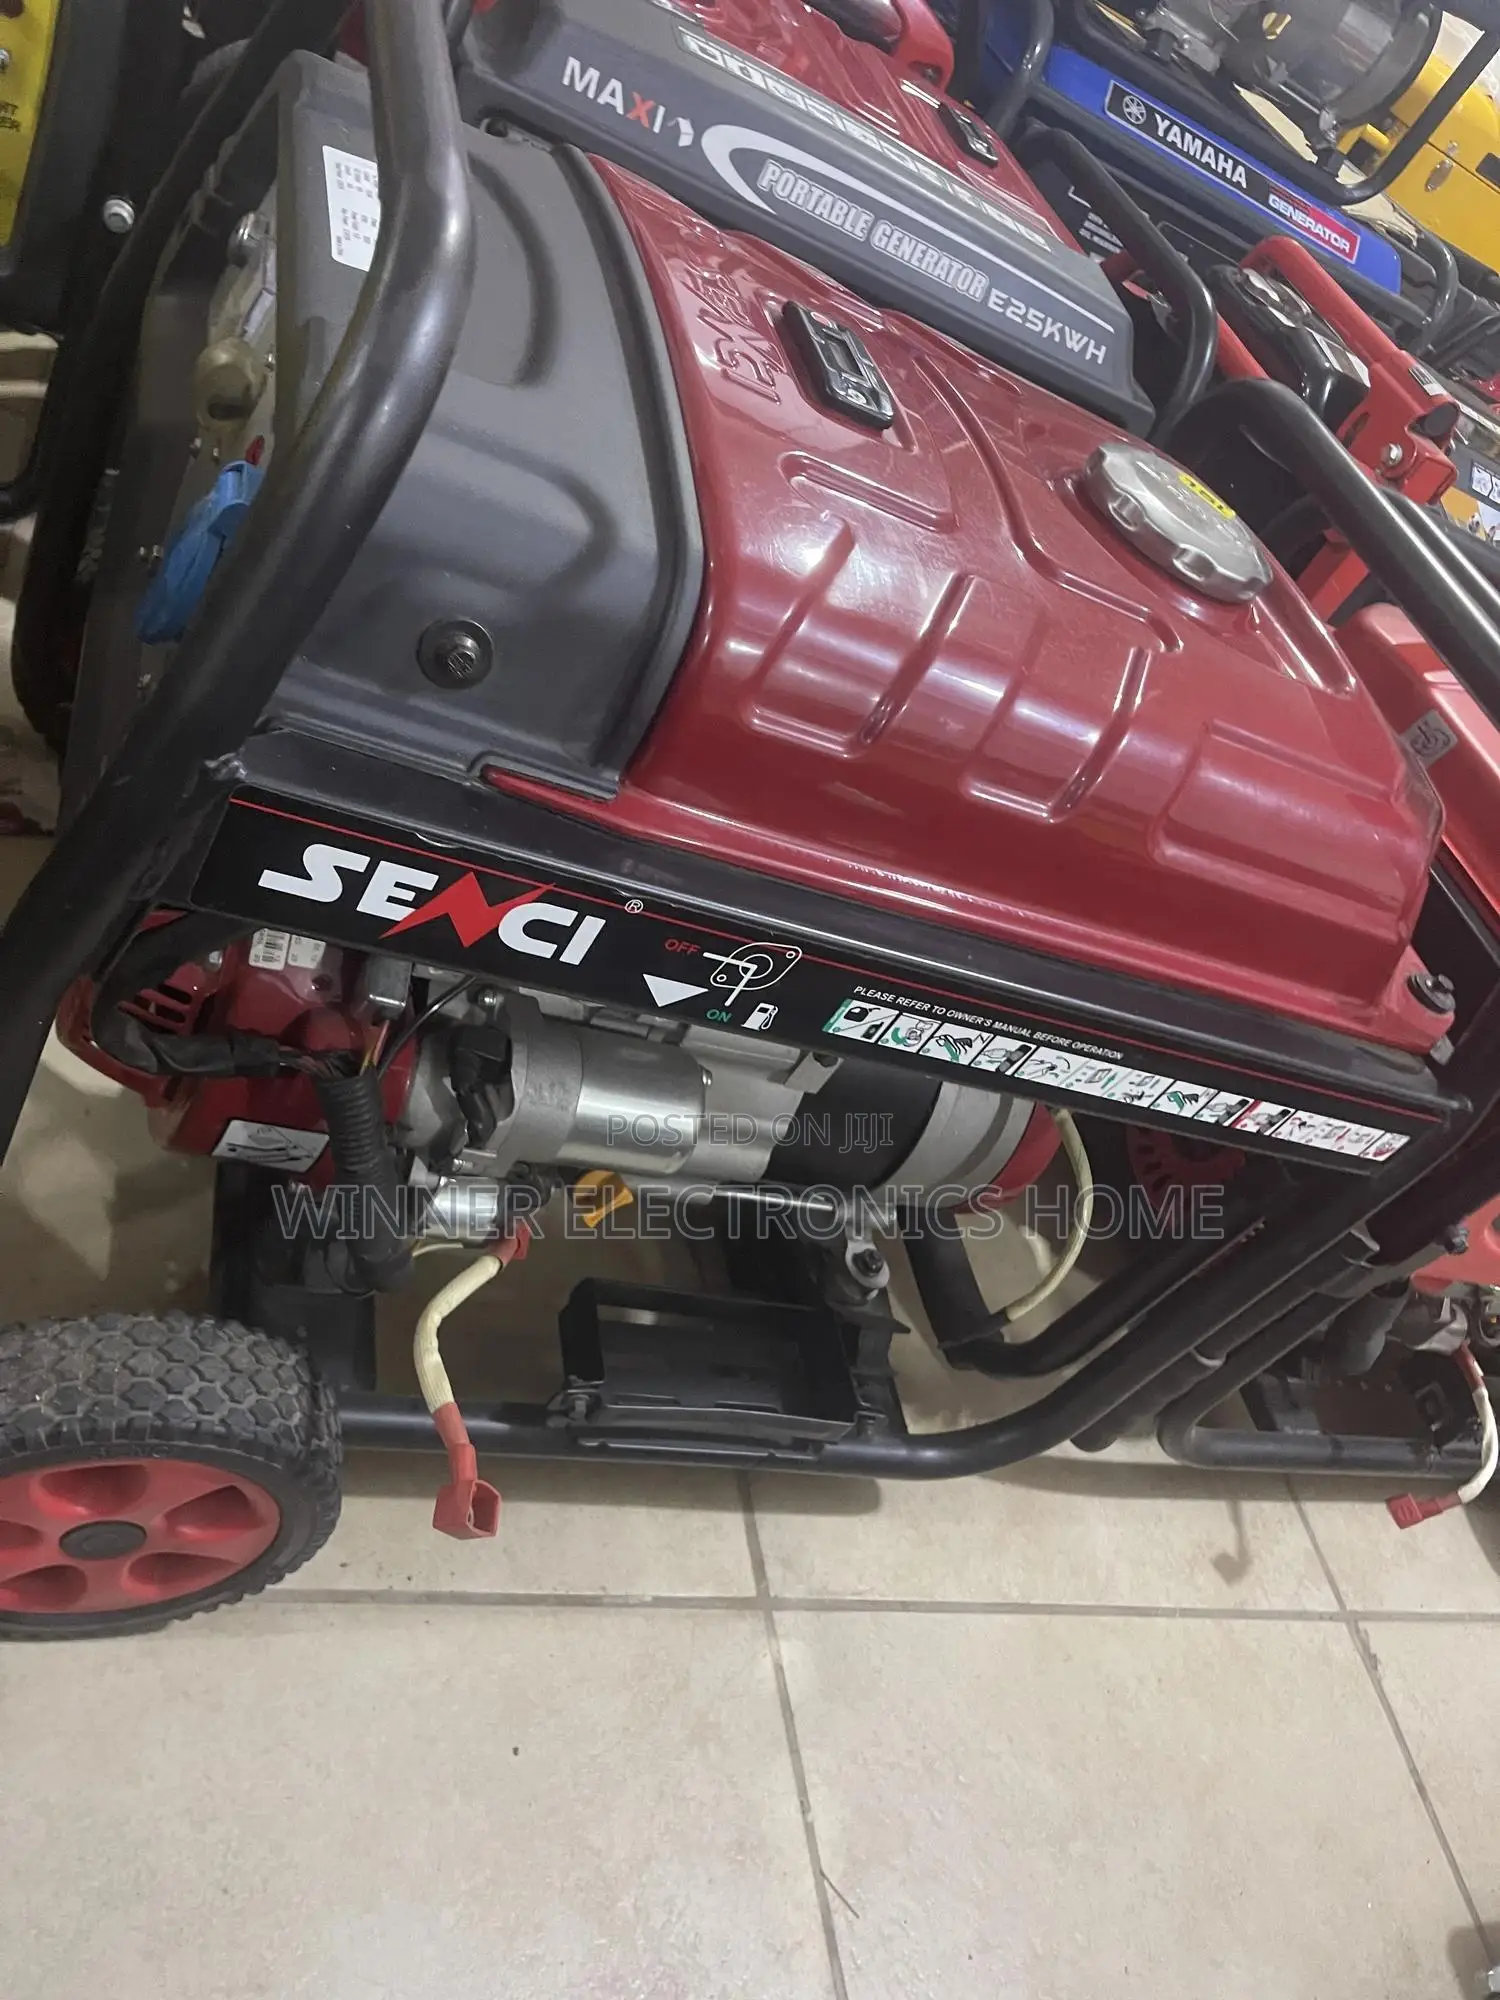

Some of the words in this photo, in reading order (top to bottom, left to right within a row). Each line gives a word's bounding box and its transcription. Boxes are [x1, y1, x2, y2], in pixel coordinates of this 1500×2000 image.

[562, 56, 666, 134] MAXI
[1154, 113, 1248, 189] YAMAHA
[1268, 192, 1350, 254] GENERATOR
[757, 159, 875, 242] PORTABLE
[869, 218, 990, 303] GENERATOR
[987, 287, 1107, 365] E25KWH
[257, 843, 606, 966] SENCI
[664, 938, 701, 955] OFF
[706, 1008, 732, 1023] ON
[854, 985, 895, 1003] PLEASE
[896, 996, 931, 1012] REFER
[931, 1004, 946, 1016] TO
[946, 1008, 993, 1027] OWNER'S
[992, 1020, 1033, 1039] MANUAL
[1033, 1030, 1073, 1049] BEFORE
[1071, 1040, 1124, 1061] OPERATION
